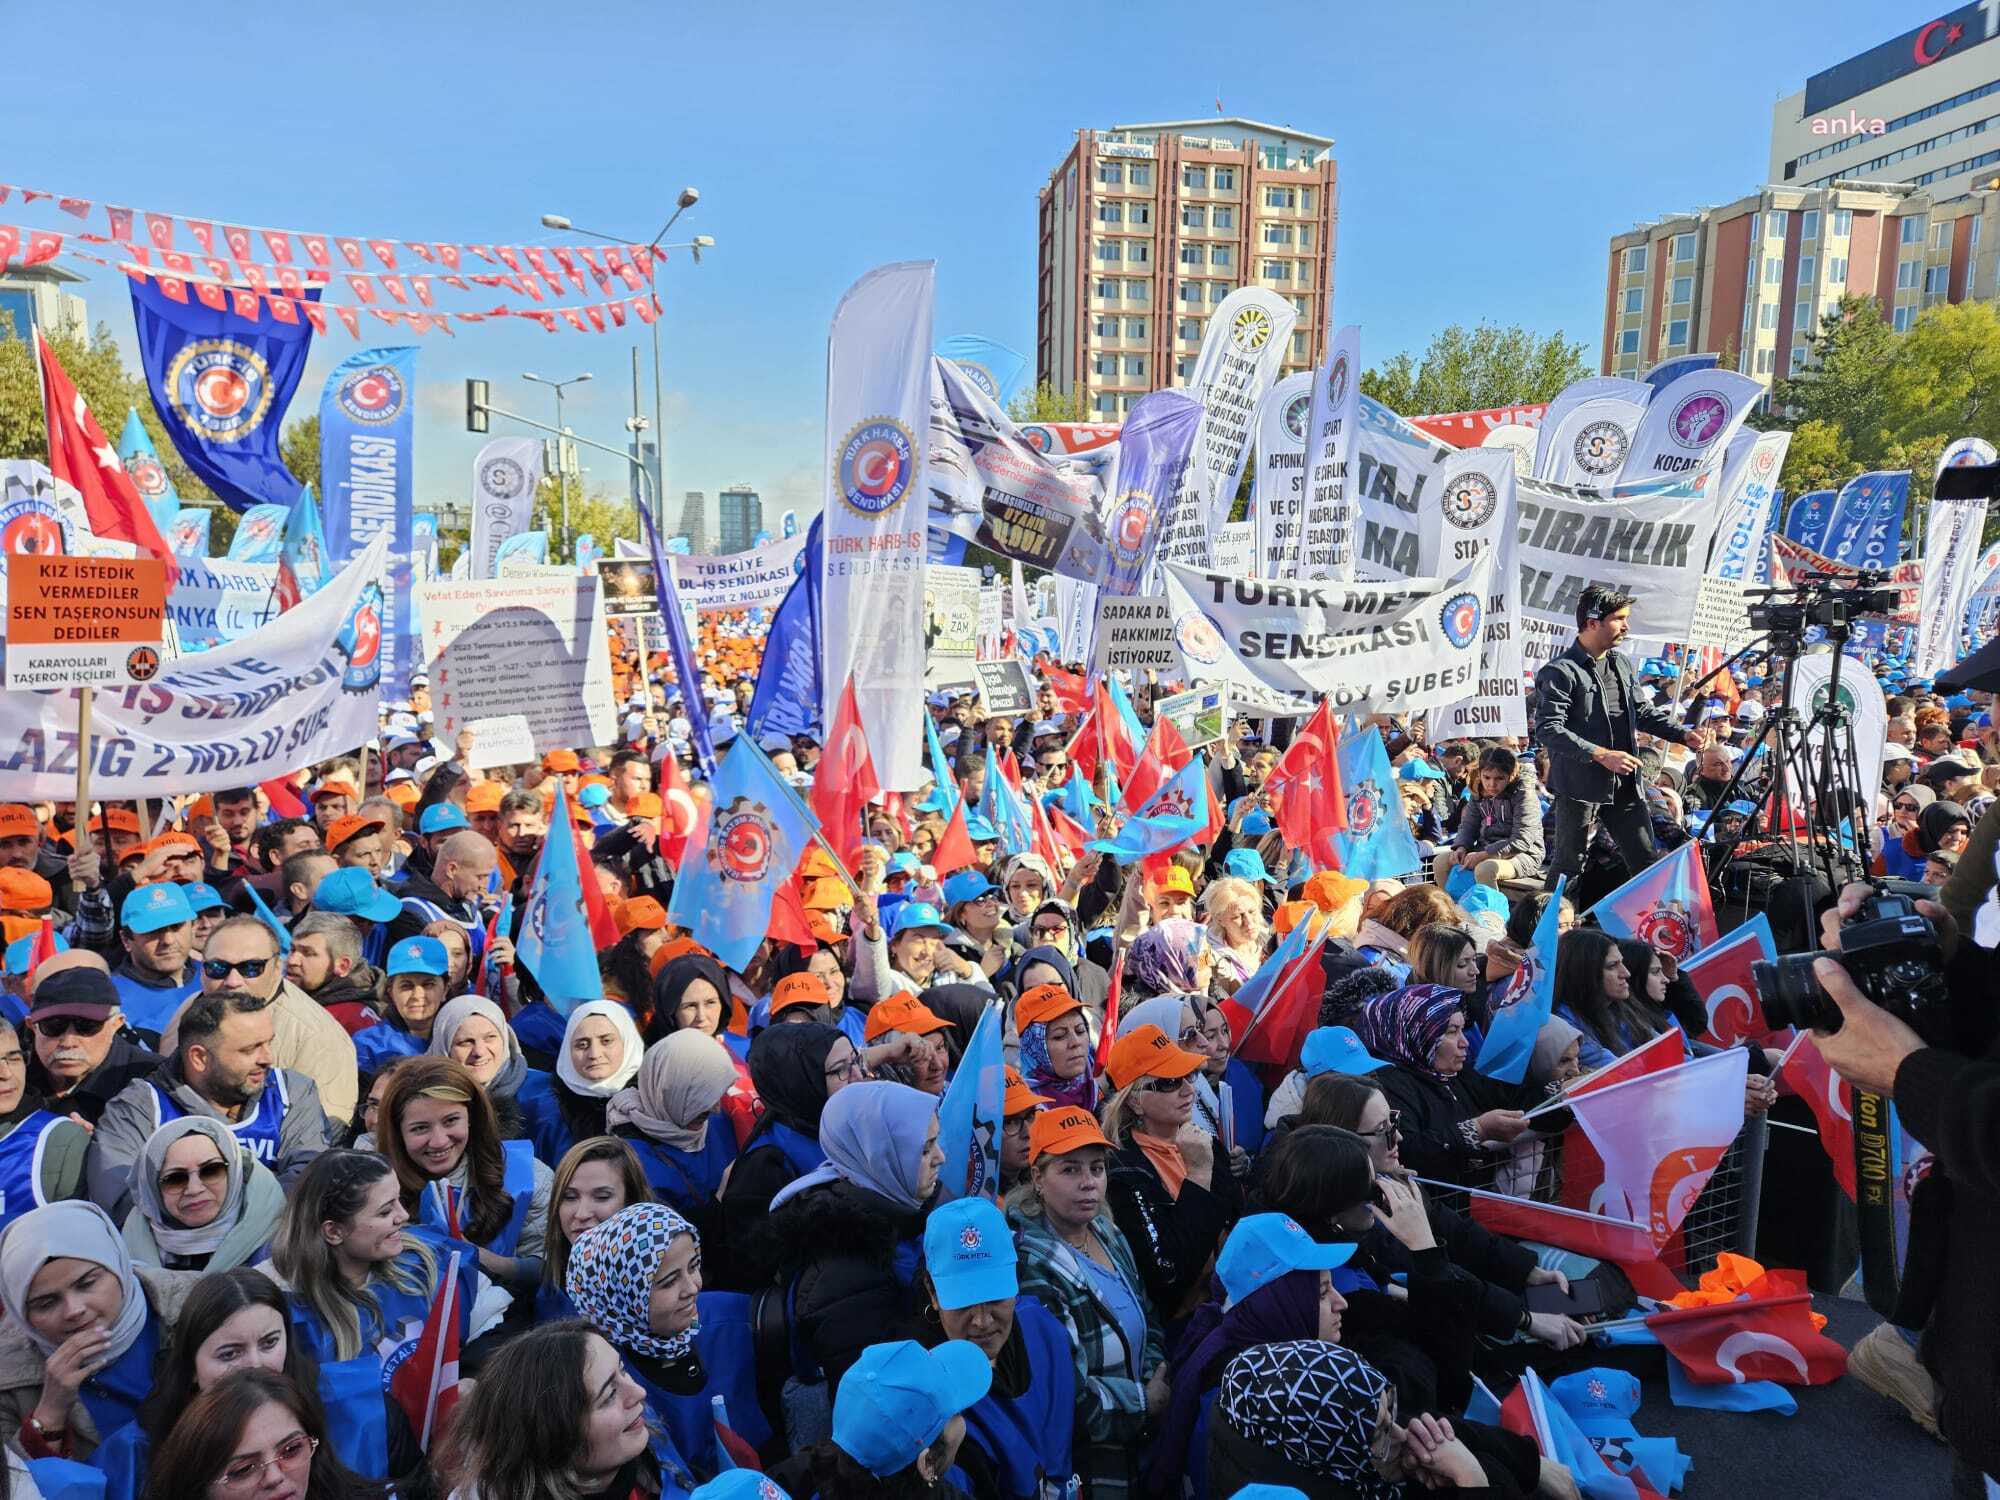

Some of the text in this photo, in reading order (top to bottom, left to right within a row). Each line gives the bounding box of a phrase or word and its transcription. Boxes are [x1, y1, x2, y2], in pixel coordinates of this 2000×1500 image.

[1222, 352, 1256, 377] TRAKYA
[1222, 372, 1245, 390] STAJ
[338, 435, 396, 544] SENDİKASI
[848, 482, 903, 510] SENDİKASI
[828, 534, 864, 554] TÜRK
[40, 561, 135, 580] KIZ İSTEDİK
[696, 557, 764, 575] TÜRKİYE
[719, 566, 790, 590] SENDİKASI
[40, 585, 139, 600] VERMEDİLER
[455, 590, 481, 600] Eden
[13, 606, 160, 622] SEN TAŞERONSUN
[1103, 606, 1151, 620] SADAKA
[54, 625, 120, 640] DEDİLER
[29, 657, 107, 669] KARAYOLLARI
[1108, 647, 1174, 665] İSTİYORUZ.
[13, 669, 116, 685] TAŞERON İŞÇİLERİ
[1387, 657, 1473, 702] ŞUBESİ
[1454, 706, 1501, 725] OLSUN
[143, 744, 178, 777] 2
[1861, 1132, 1887, 1180] D700
[954, 1251, 992, 1261] TÜRK METAL
